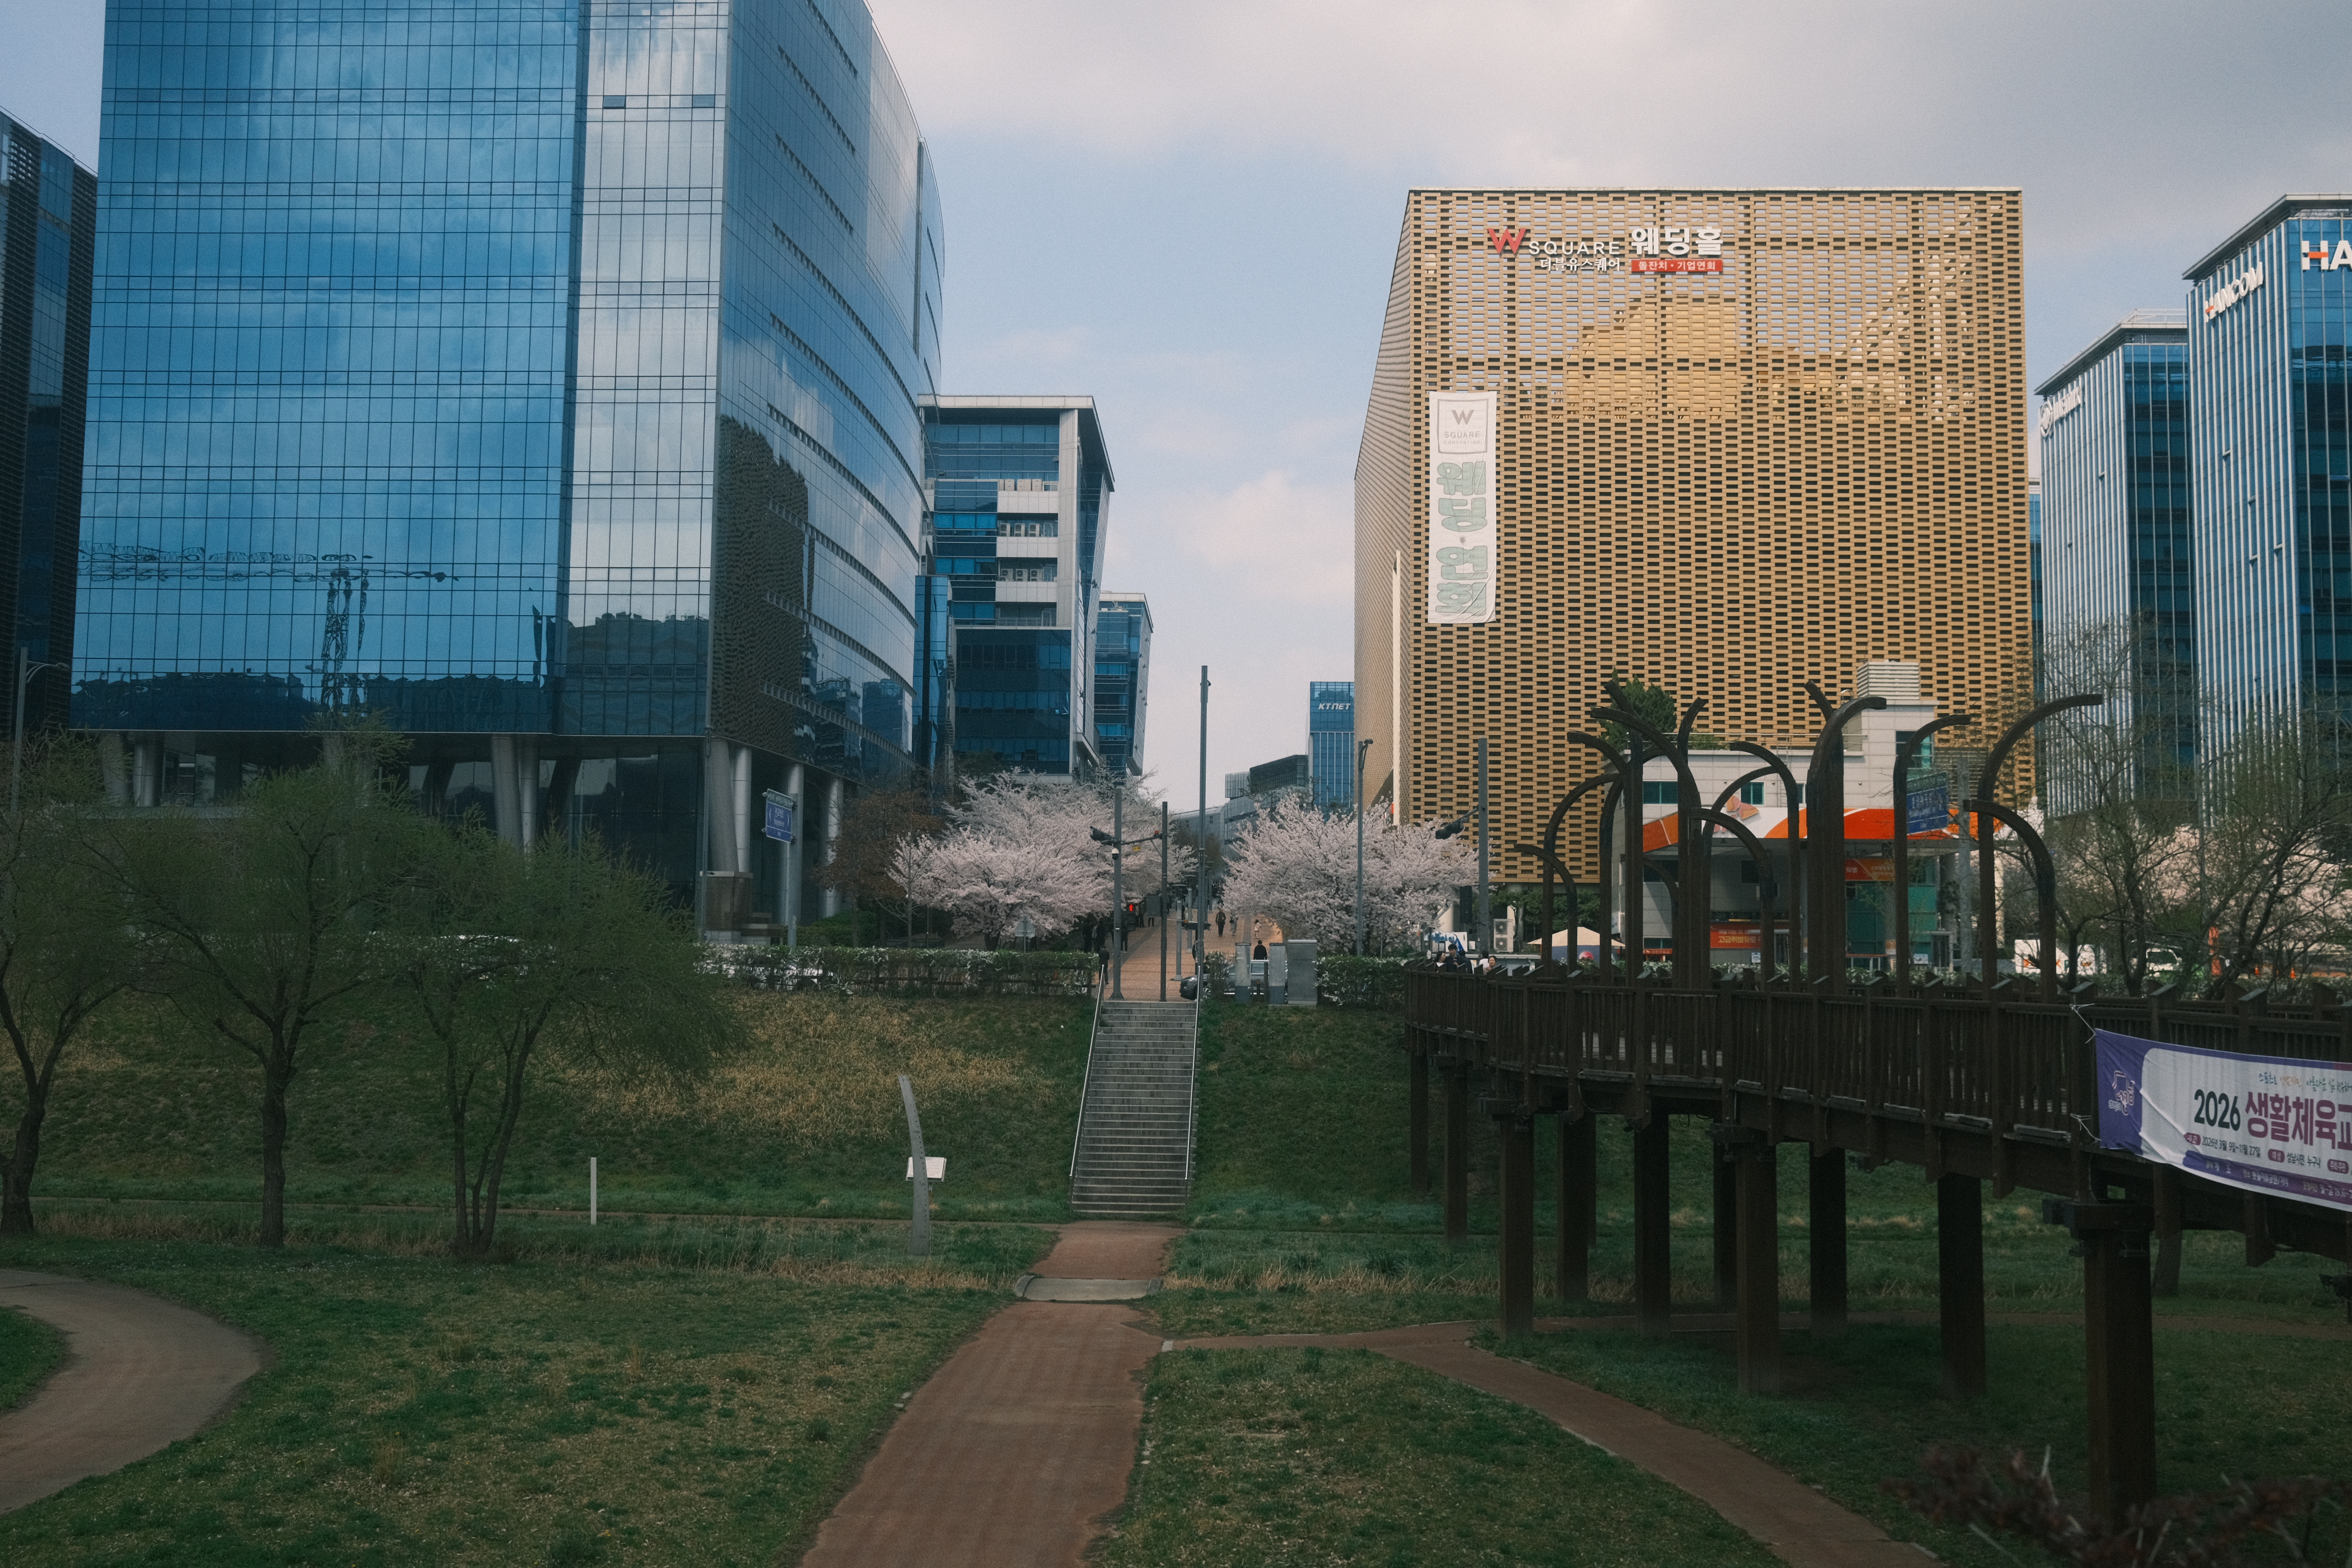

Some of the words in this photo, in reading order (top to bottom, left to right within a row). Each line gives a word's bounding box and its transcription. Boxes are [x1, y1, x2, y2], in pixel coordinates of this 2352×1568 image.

[1488, 228, 1526, 255] W
[1529, 241, 1621, 255] SQUARE
[1631, 226, 1724, 256] 웨딩홀
[1540, 258, 1620, 272] 더블유스퀘어
[1639, 261, 1668, 271] 돌잔치
[1677, 261, 1716, 271] 기업연회
[2302, 240, 2352, 270] HA
[2204, 262, 2264, 323] HANCOM
[1451, 410, 1474, 425] W
[2194, 1089, 2241, 1131] 2026
[2286, 1152, 2305, 1165] 성남시민
[2307, 1155, 2321, 1168] 누구나
